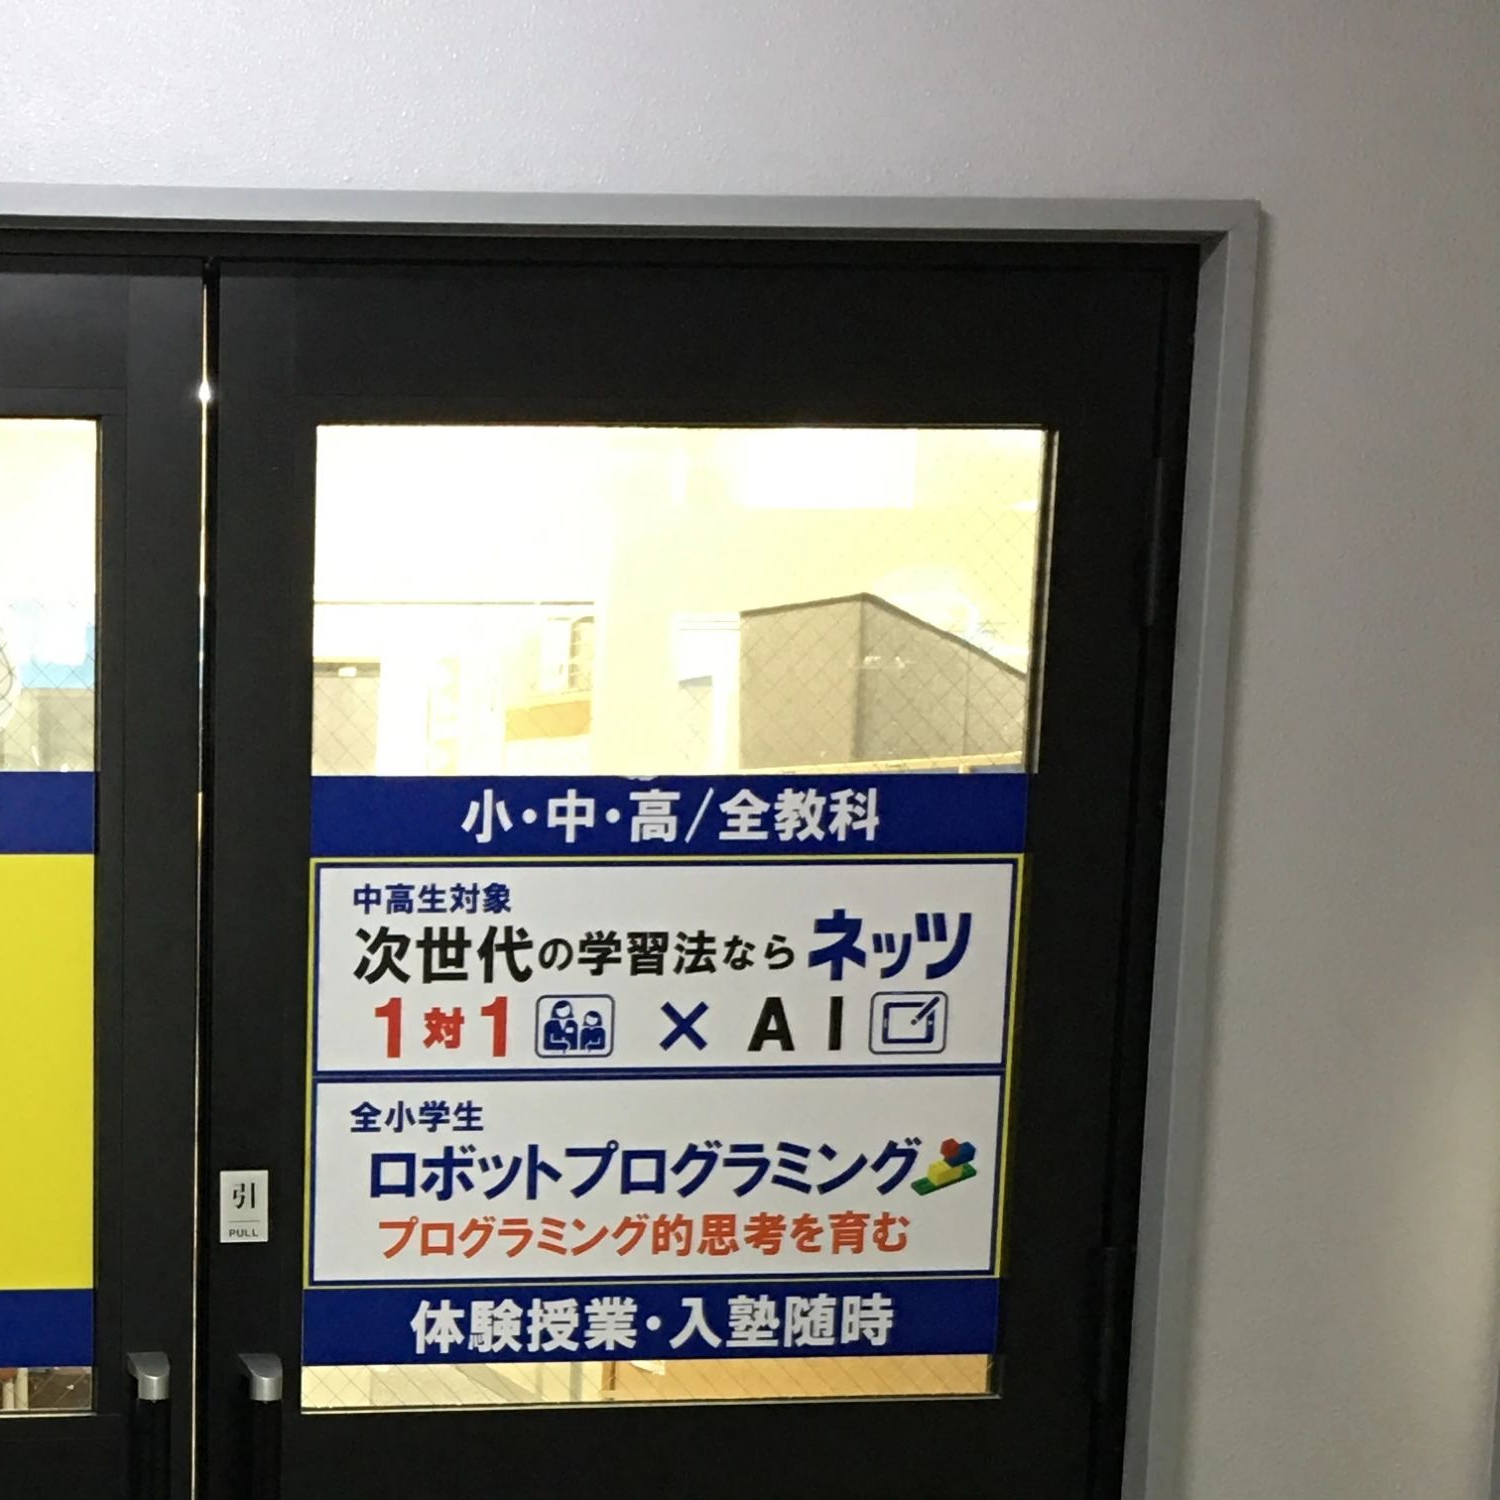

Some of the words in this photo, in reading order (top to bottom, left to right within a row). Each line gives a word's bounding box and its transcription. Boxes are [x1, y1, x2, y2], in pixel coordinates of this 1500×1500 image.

[352, 883, 512, 916] 中高生対象
[373, 996, 509, 1059] 1対1
[350, 1100, 484, 1133] 全小学生
[370, 1137, 922, 1201] ロボットプログラミング
[233, 1182, 256, 1209] 引
[229, 1228, 258, 1237] PULL
[378, 1211, 908, 1259] プログラミング的思考を育む
[411, 1295, 895, 1354] 体験授業・入塾随時
